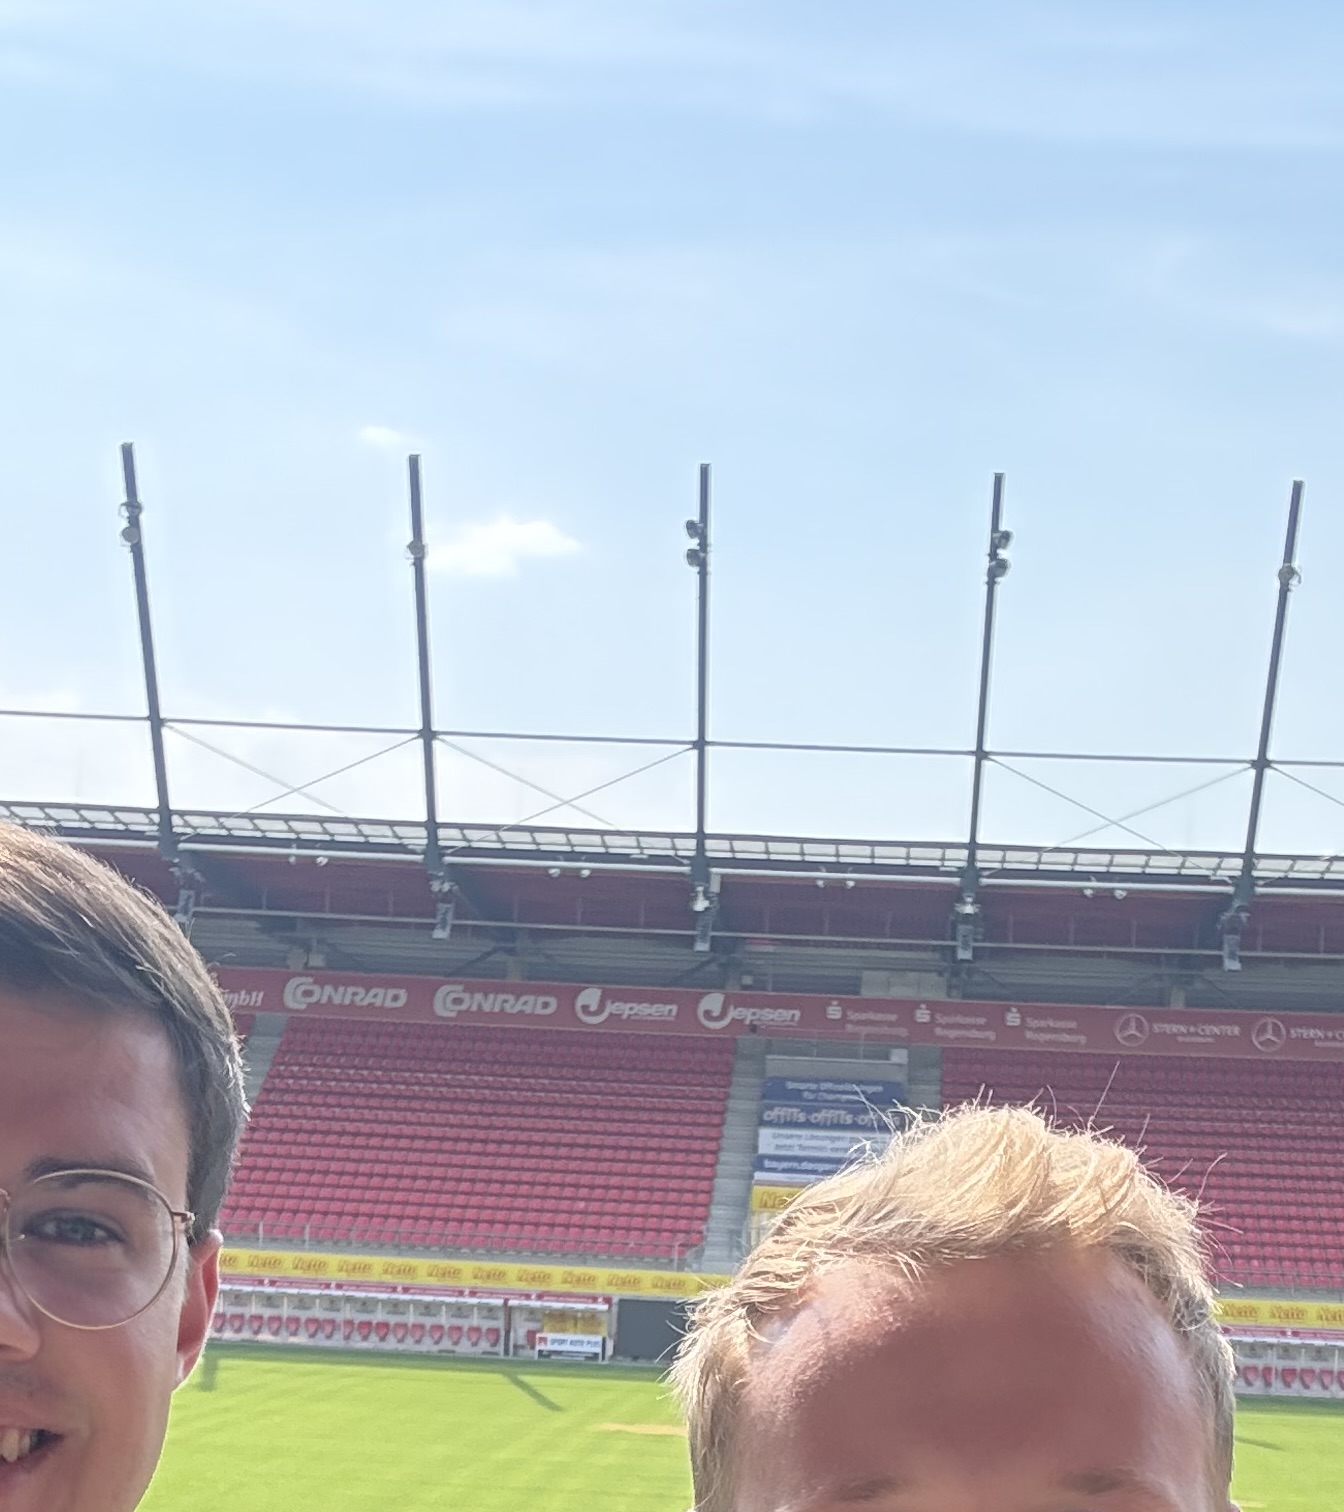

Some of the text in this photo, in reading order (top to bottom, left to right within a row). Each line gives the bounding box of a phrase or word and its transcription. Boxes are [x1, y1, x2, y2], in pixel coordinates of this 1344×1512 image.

[283, 976, 407, 1009] CONRAD
[433, 985, 558, 1017] CONRAD
[1197, 1024, 1241, 1037] CENTER
